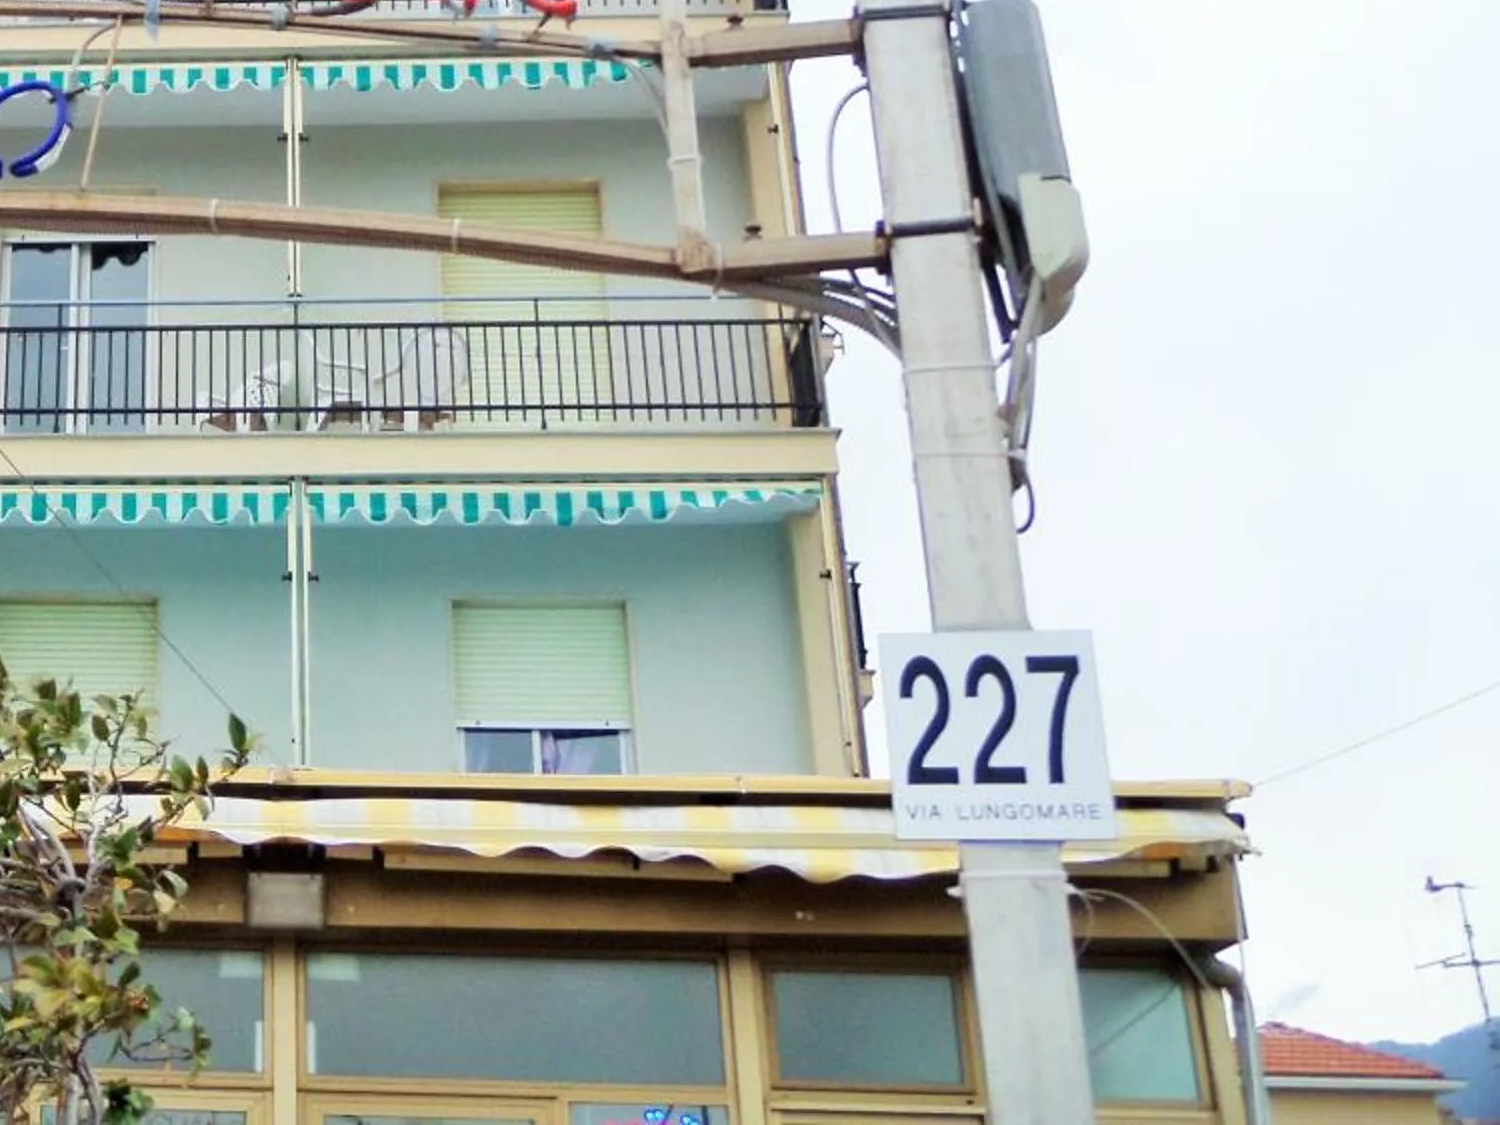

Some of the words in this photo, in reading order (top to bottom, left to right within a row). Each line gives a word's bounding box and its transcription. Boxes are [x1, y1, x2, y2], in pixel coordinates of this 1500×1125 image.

[899, 654, 1080, 785] 227
[906, 803, 942, 820] VIA
[957, 802, 1102, 821] LUNGOMARE
